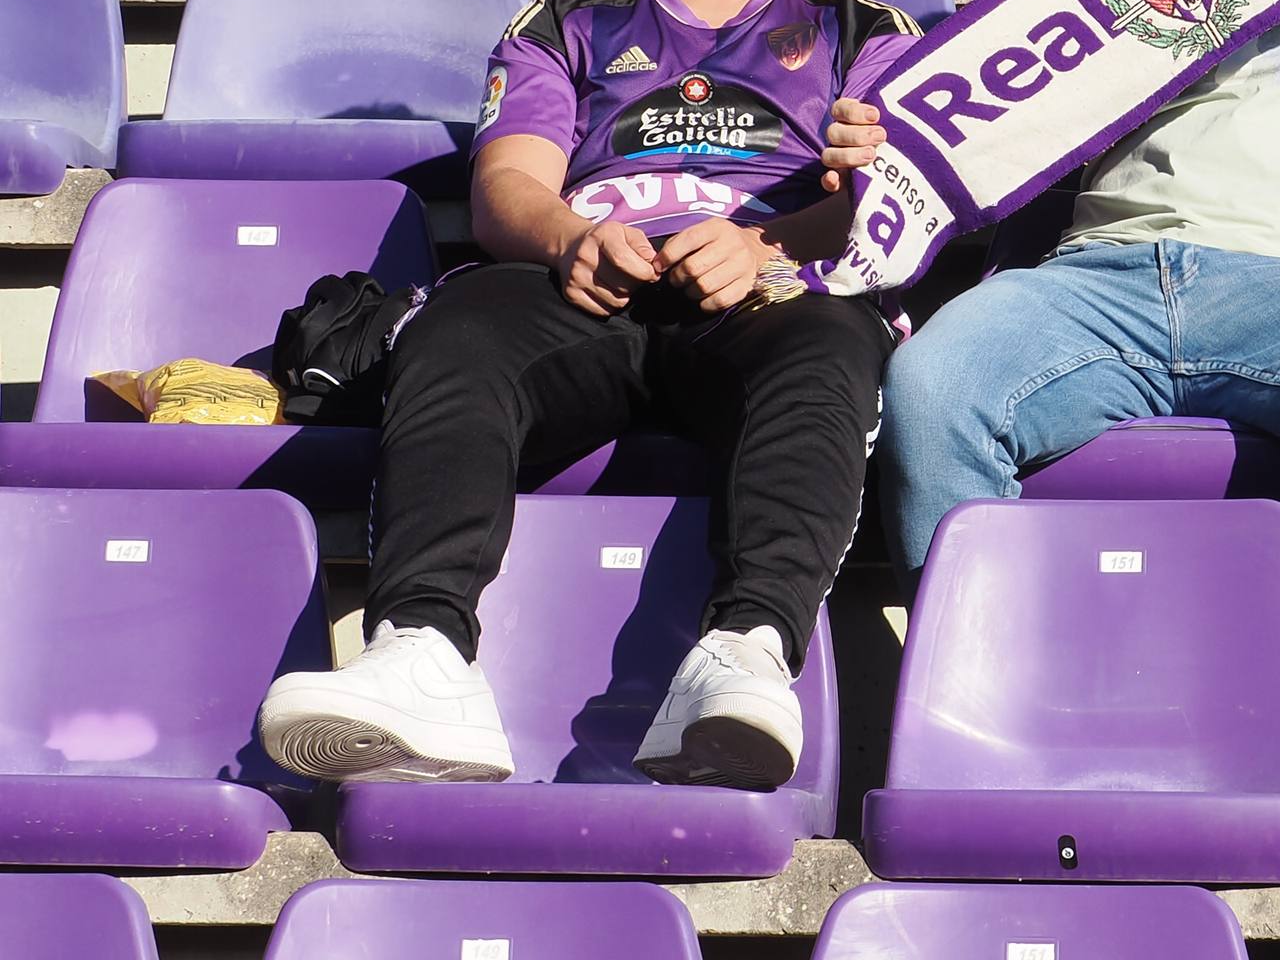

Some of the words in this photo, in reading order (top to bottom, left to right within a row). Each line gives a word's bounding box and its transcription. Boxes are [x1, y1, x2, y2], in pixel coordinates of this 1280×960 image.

[605, 62, 658, 75] adidas
[639, 108, 755, 133] Estrella
[642, 126, 748, 148] Galicia
[117, 547, 140, 558] 147
[612, 553, 636, 565] 149
[1112, 557, 1134, 569] 151
